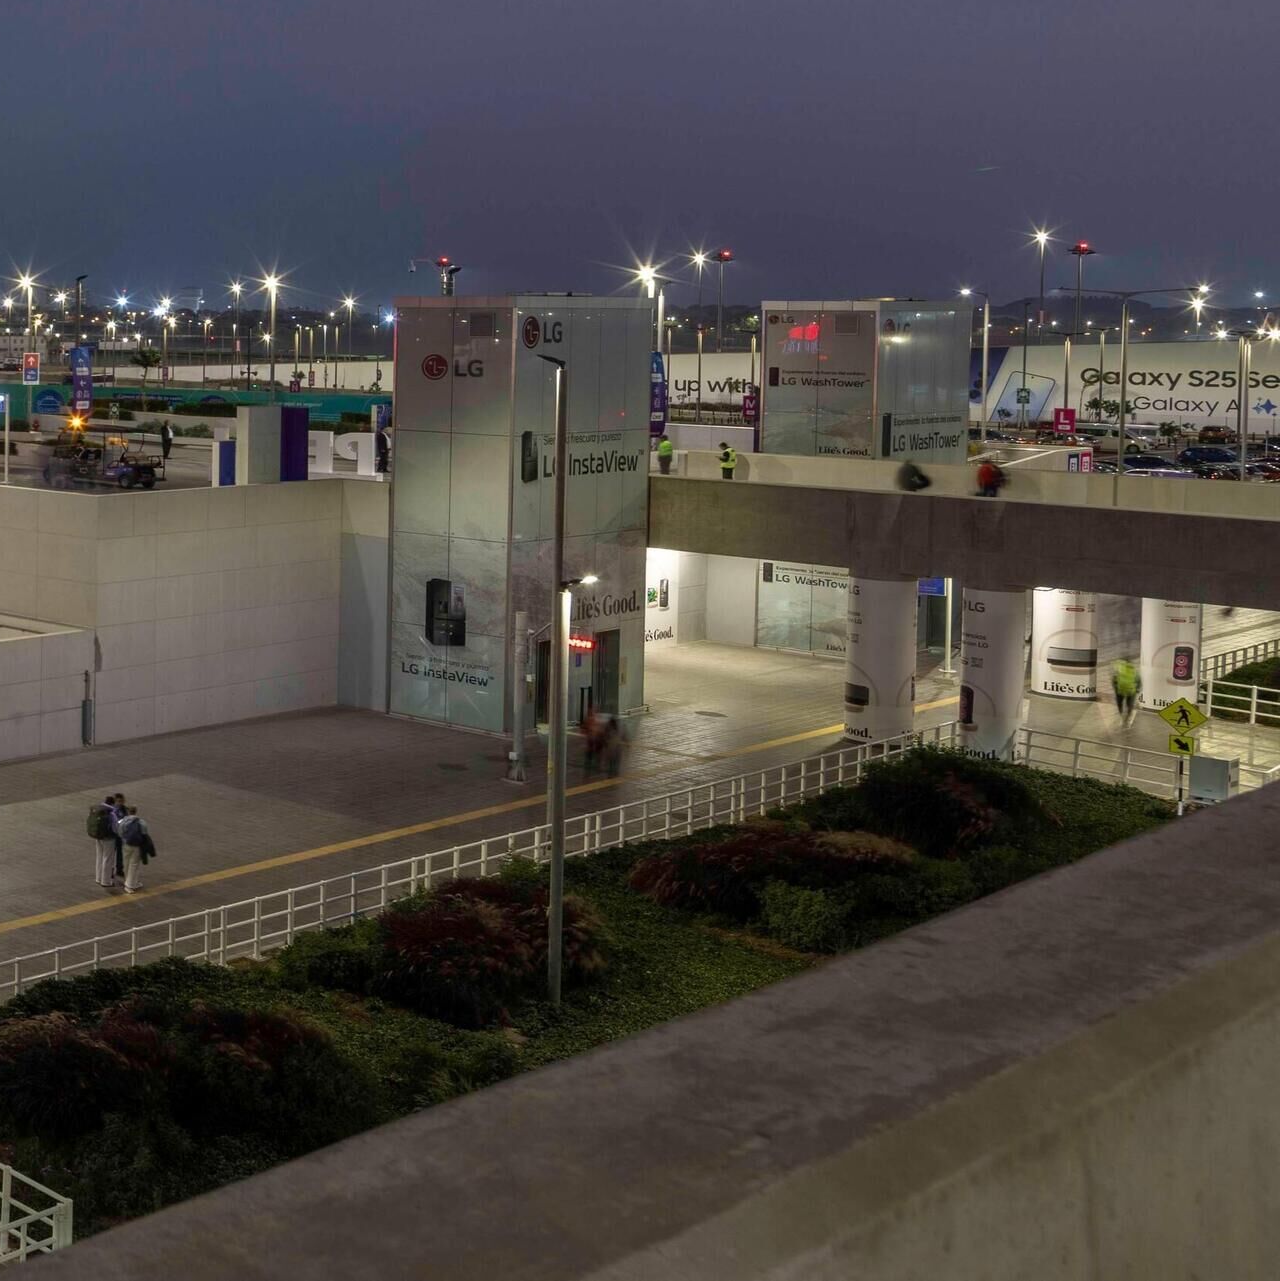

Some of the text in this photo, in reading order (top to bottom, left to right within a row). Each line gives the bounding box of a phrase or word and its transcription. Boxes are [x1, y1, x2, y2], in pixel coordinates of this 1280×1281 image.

[781, 316, 794, 324] LG
[543, 322, 563, 344] LG
[454, 359, 484, 377] LG
[674, 377, 754, 397] up with
[781, 377, 797, 386] LG
[1080, 368, 1183, 391] Gaaxy
[1187, 370, 1237, 388] S25
[1134, 396, 1240, 416] Galaxy A
[1060, 411, 1070, 423] L
[893, 434, 906, 452] LG
[776, 573, 848, 590] LG WashTow
[603, 589, 640, 617] Good.
[969, 601, 986, 613] LG
[653, 626, 674, 640] Good.
[401, 662, 419, 675] LG
[1043, 681, 1074, 694] Life's
[1153, 698, 1174, 708] Life'
